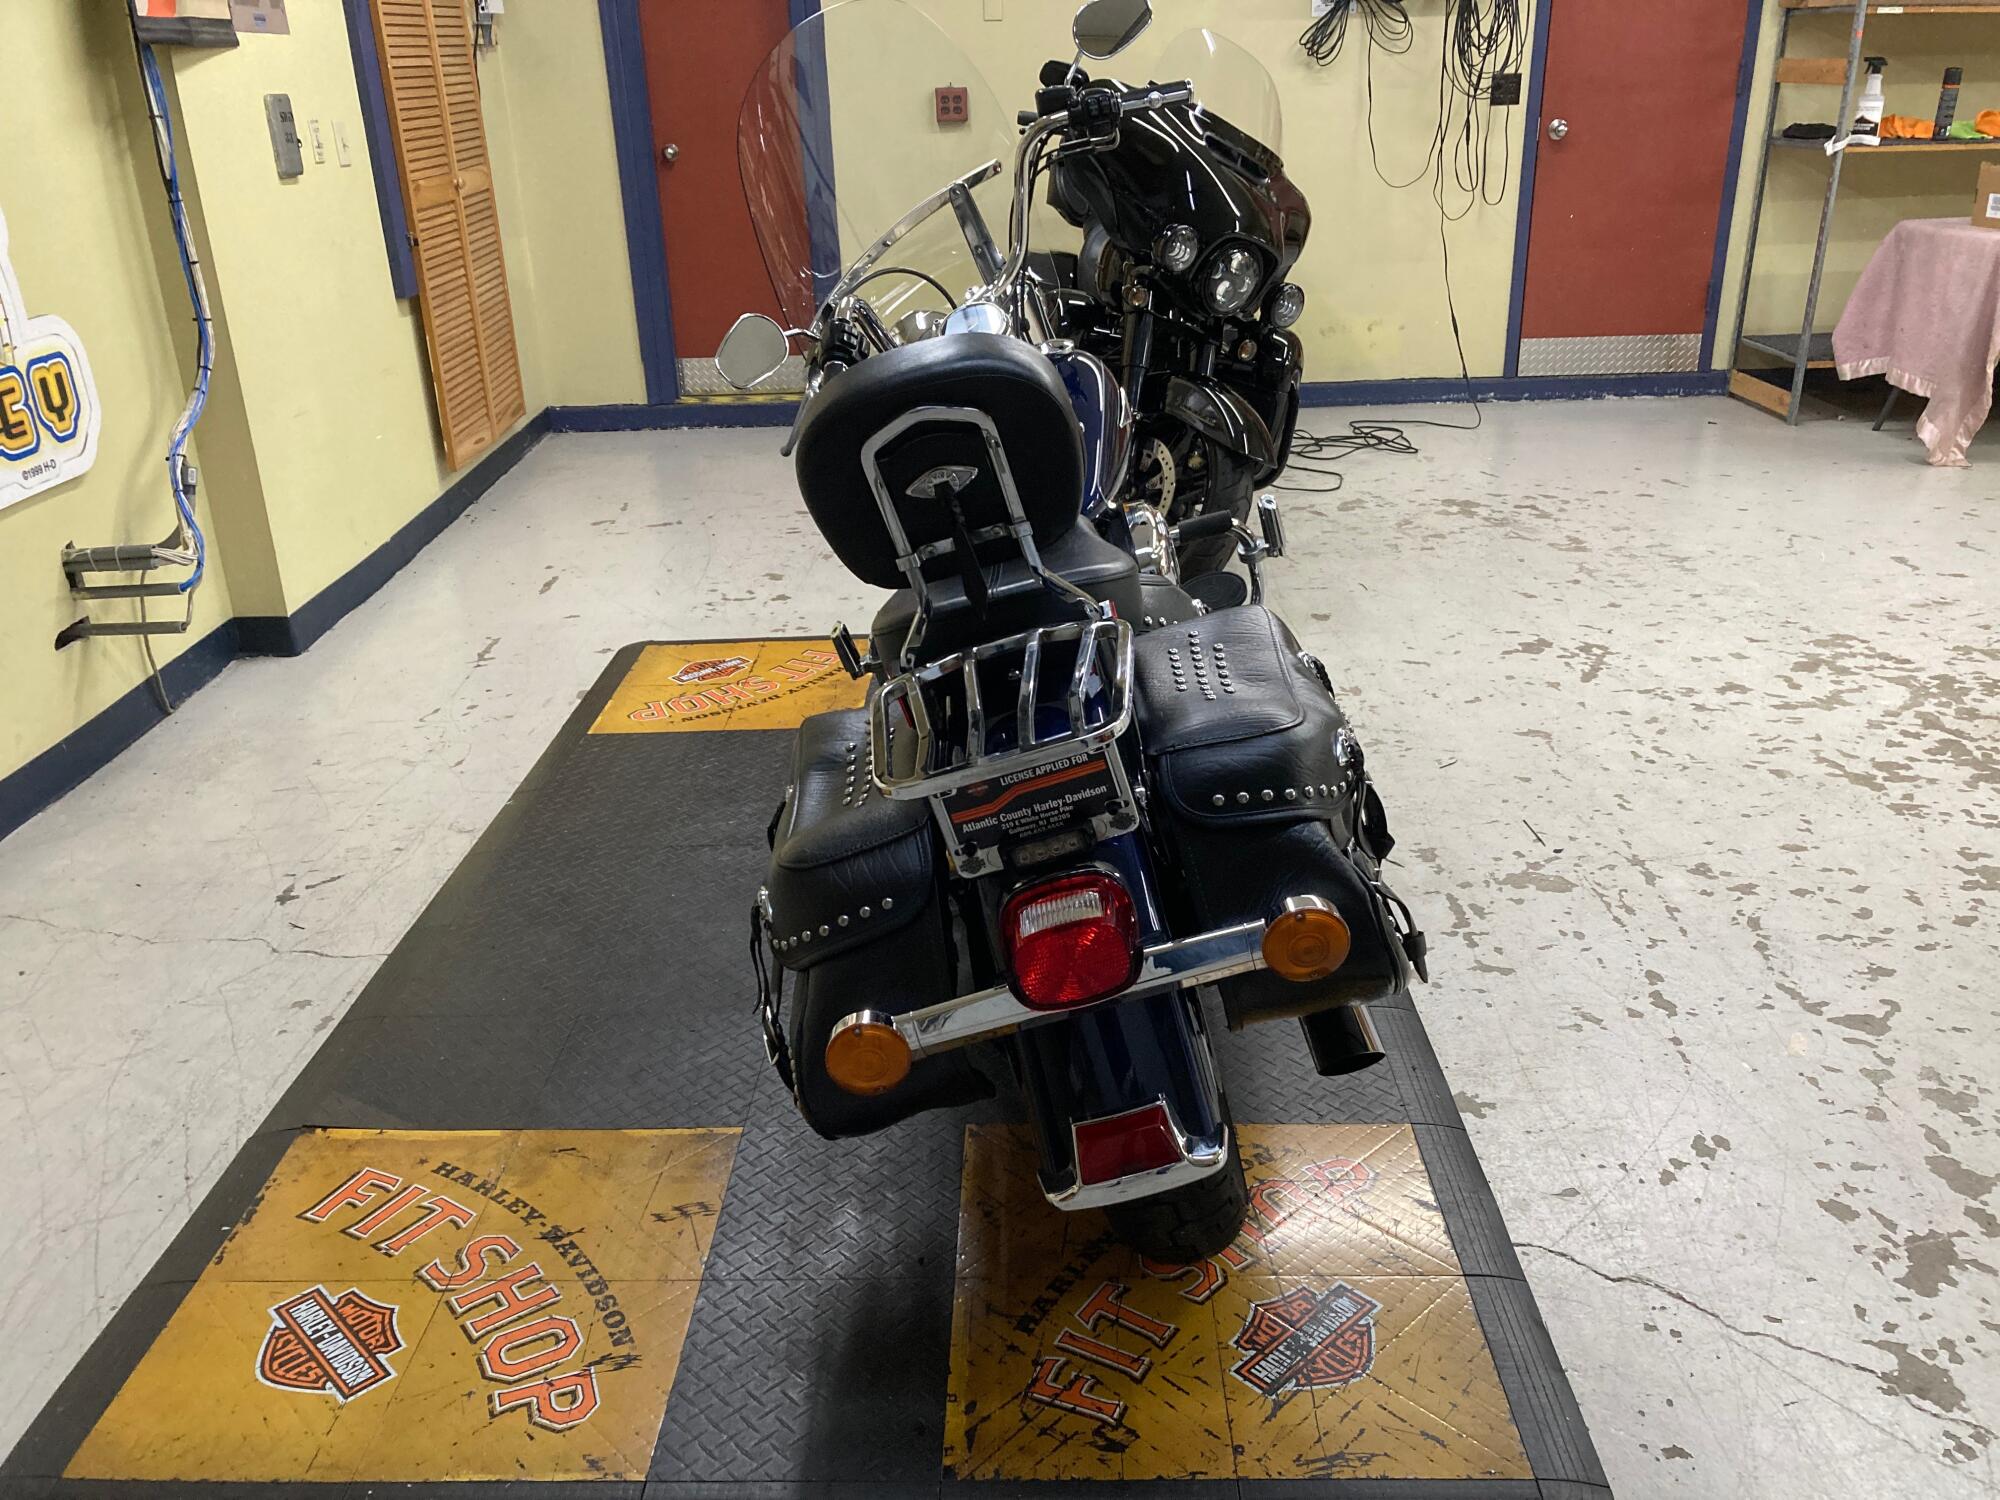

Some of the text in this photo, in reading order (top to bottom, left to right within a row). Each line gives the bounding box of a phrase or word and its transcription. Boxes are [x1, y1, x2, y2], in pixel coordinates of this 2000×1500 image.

[44, 459, 57, 472] H-D
[627, 649, 839, 721] FIT SHOP
[1000, 753, 1089, 786] LICENSE APPLIED FOR
[962, 785, 1108, 833] Atlantic County Harley-Davidson
[431, 1162, 636, 1348] HARLEY-DAVIDSON
[297, 1167, 601, 1434] FIT SHOP
[338, 1303, 386, 1349] MOTOR
[272, 1333, 324, 1382] CYCLES
[289, 1299, 376, 1387] HARLEY-DAVIDSON
[1025, 1281, 1180, 1426] FIT
